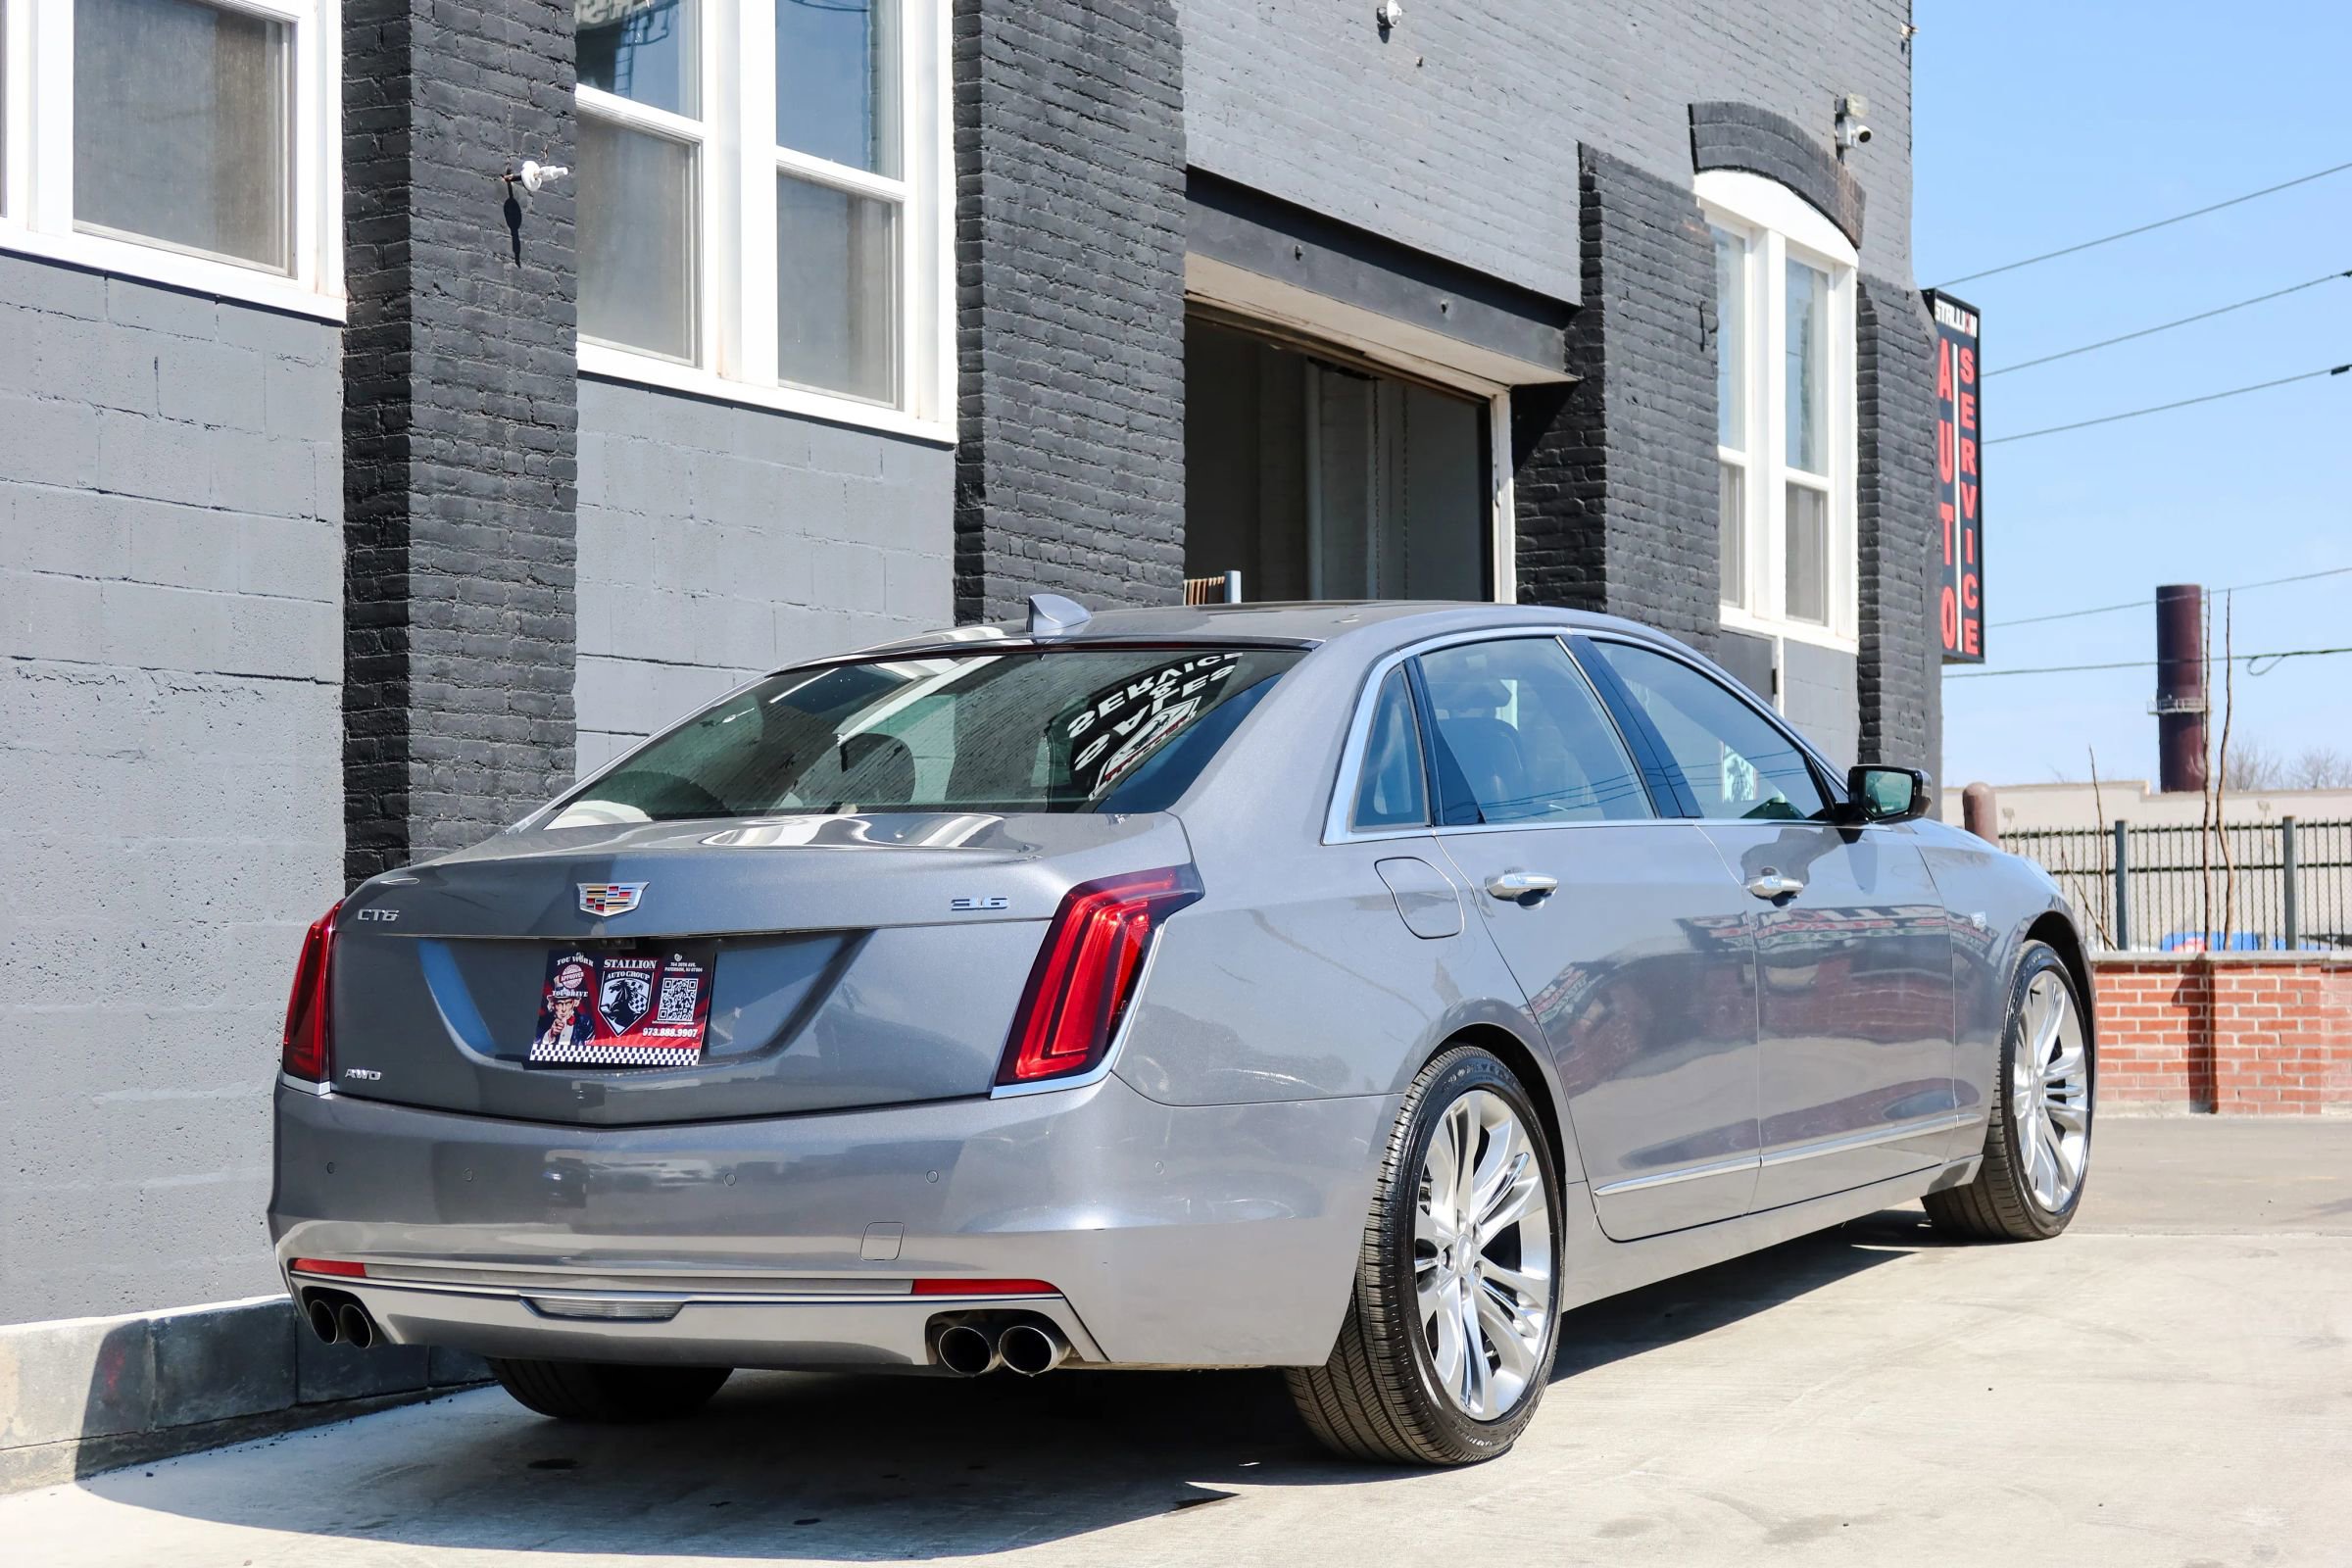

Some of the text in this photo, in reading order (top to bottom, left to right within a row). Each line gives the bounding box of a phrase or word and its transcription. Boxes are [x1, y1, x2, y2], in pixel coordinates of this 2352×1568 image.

[1937, 337, 1956, 650] AUTO
[1960, 347, 1980, 656] SERVICE
[357, 908, 400, 921] CT6
[604, 958, 657, 969] STALLION
[606, 970, 651, 981] AUTO GROUP
[642, 1027, 699, 1038] 973.888.9907
[345, 1068, 381, 1081] AWD
